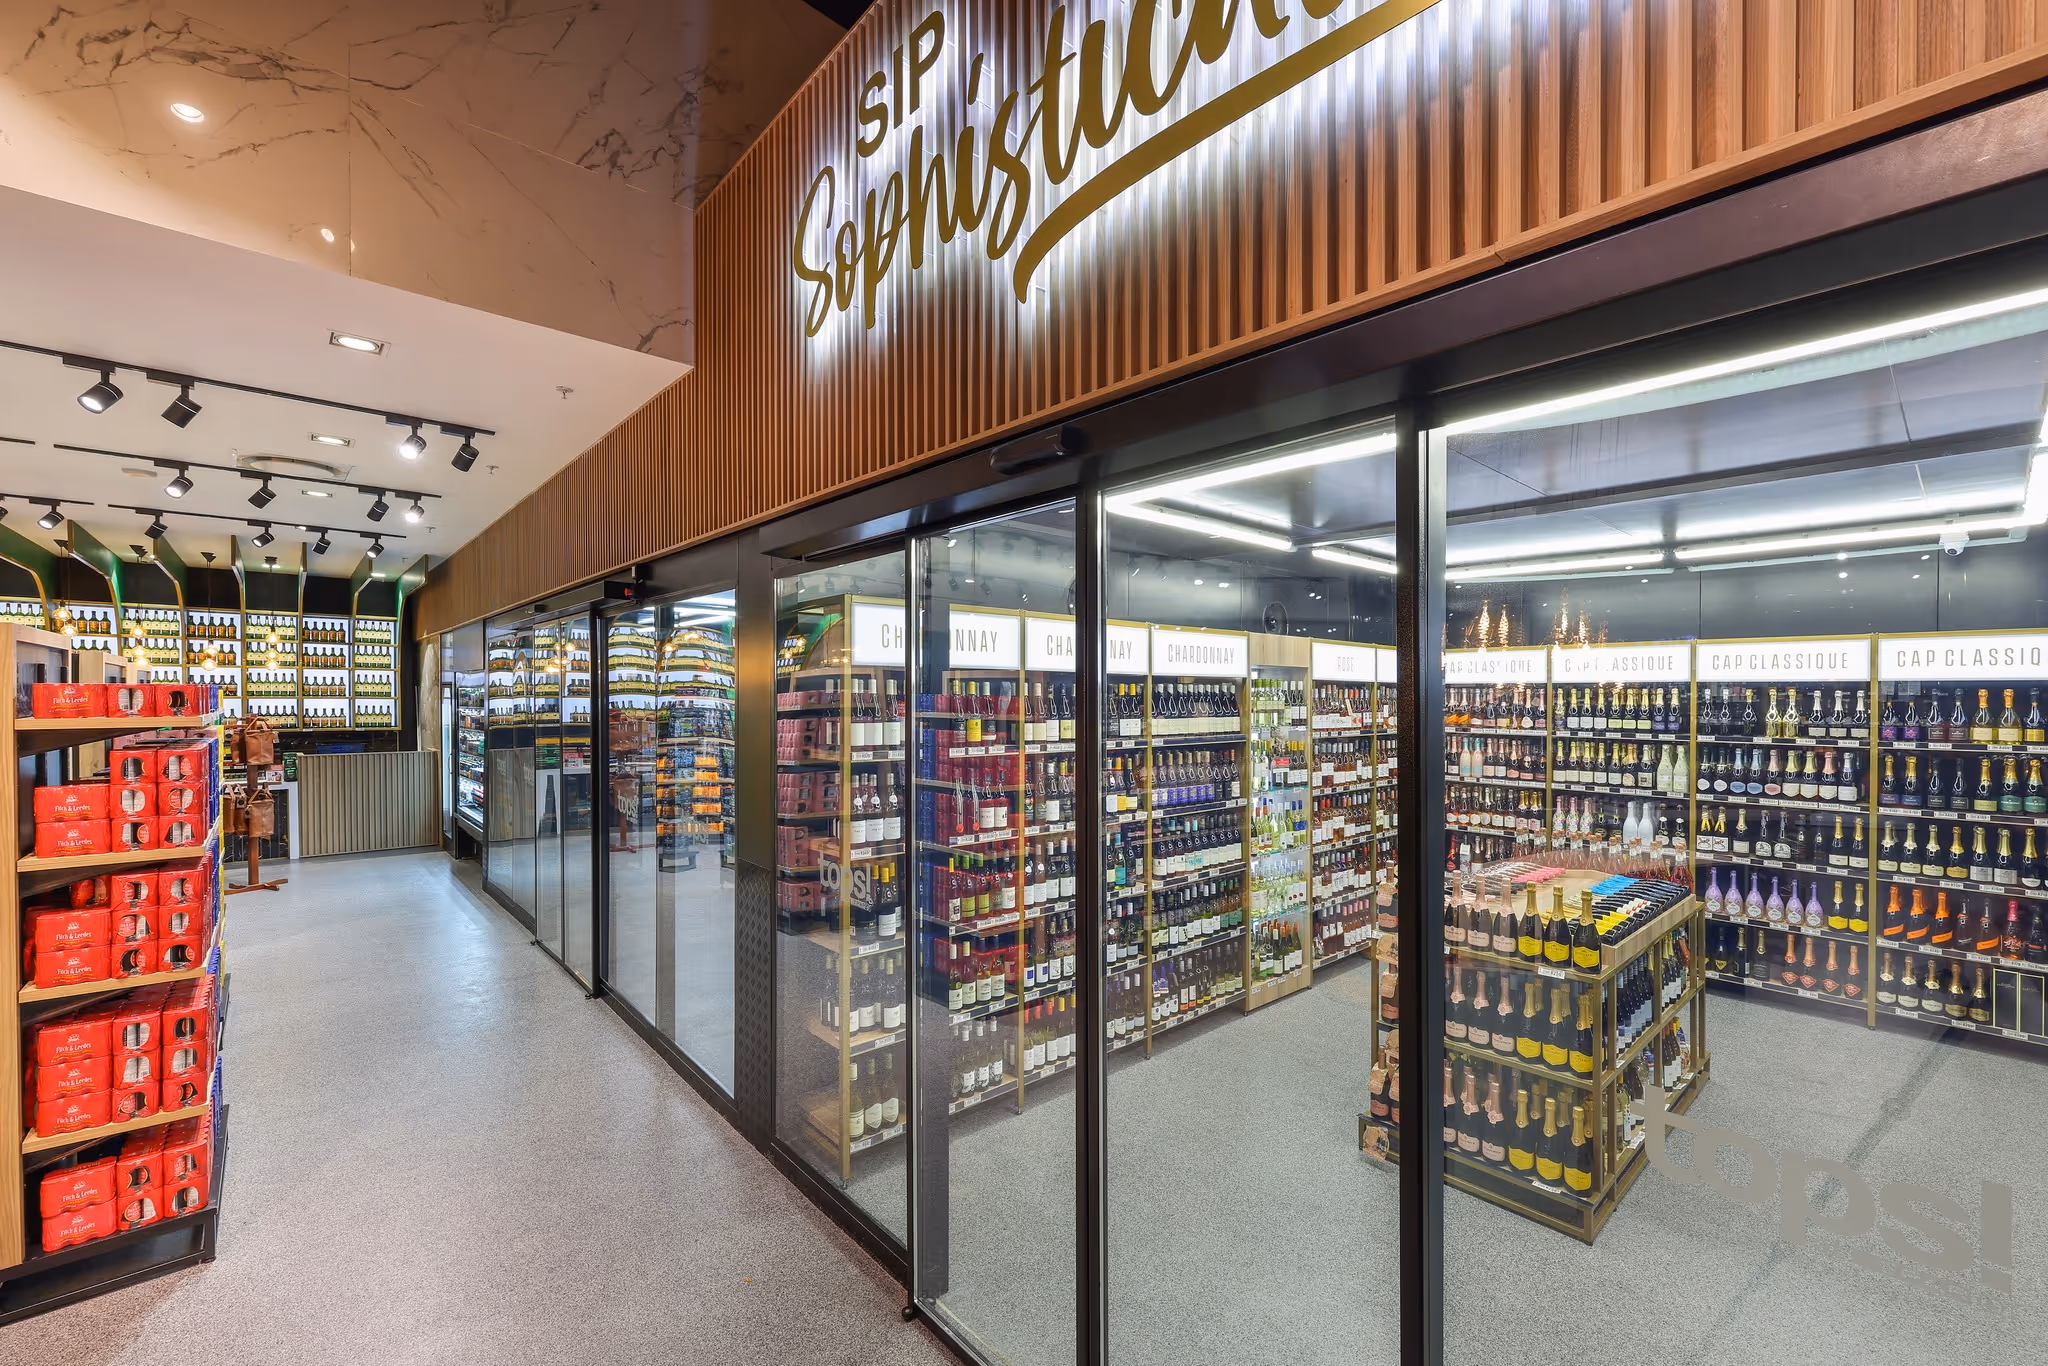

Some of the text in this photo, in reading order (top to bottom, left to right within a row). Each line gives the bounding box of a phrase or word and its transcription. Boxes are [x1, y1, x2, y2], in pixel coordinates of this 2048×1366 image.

[858, 10, 945, 158] SIP
[794, 0, 1344, 338] Sophistic
[882, 623, 997, 652] CHNNAY
[1047, 635, 1132, 660] CHANAY
[1168, 643, 1234, 664] CHARDONNAY
[1565, 656, 1673, 673] CP ASSIQUE
[1712, 652, 1849, 671] CAP CLASSIQUE
[1897, 650, 1936, 669] CAP
[1467, 659, 1532, 674] CLASIQUE
[818, 850, 872, 901] tops!
[1630, 1084, 2014, 1295] tops!
